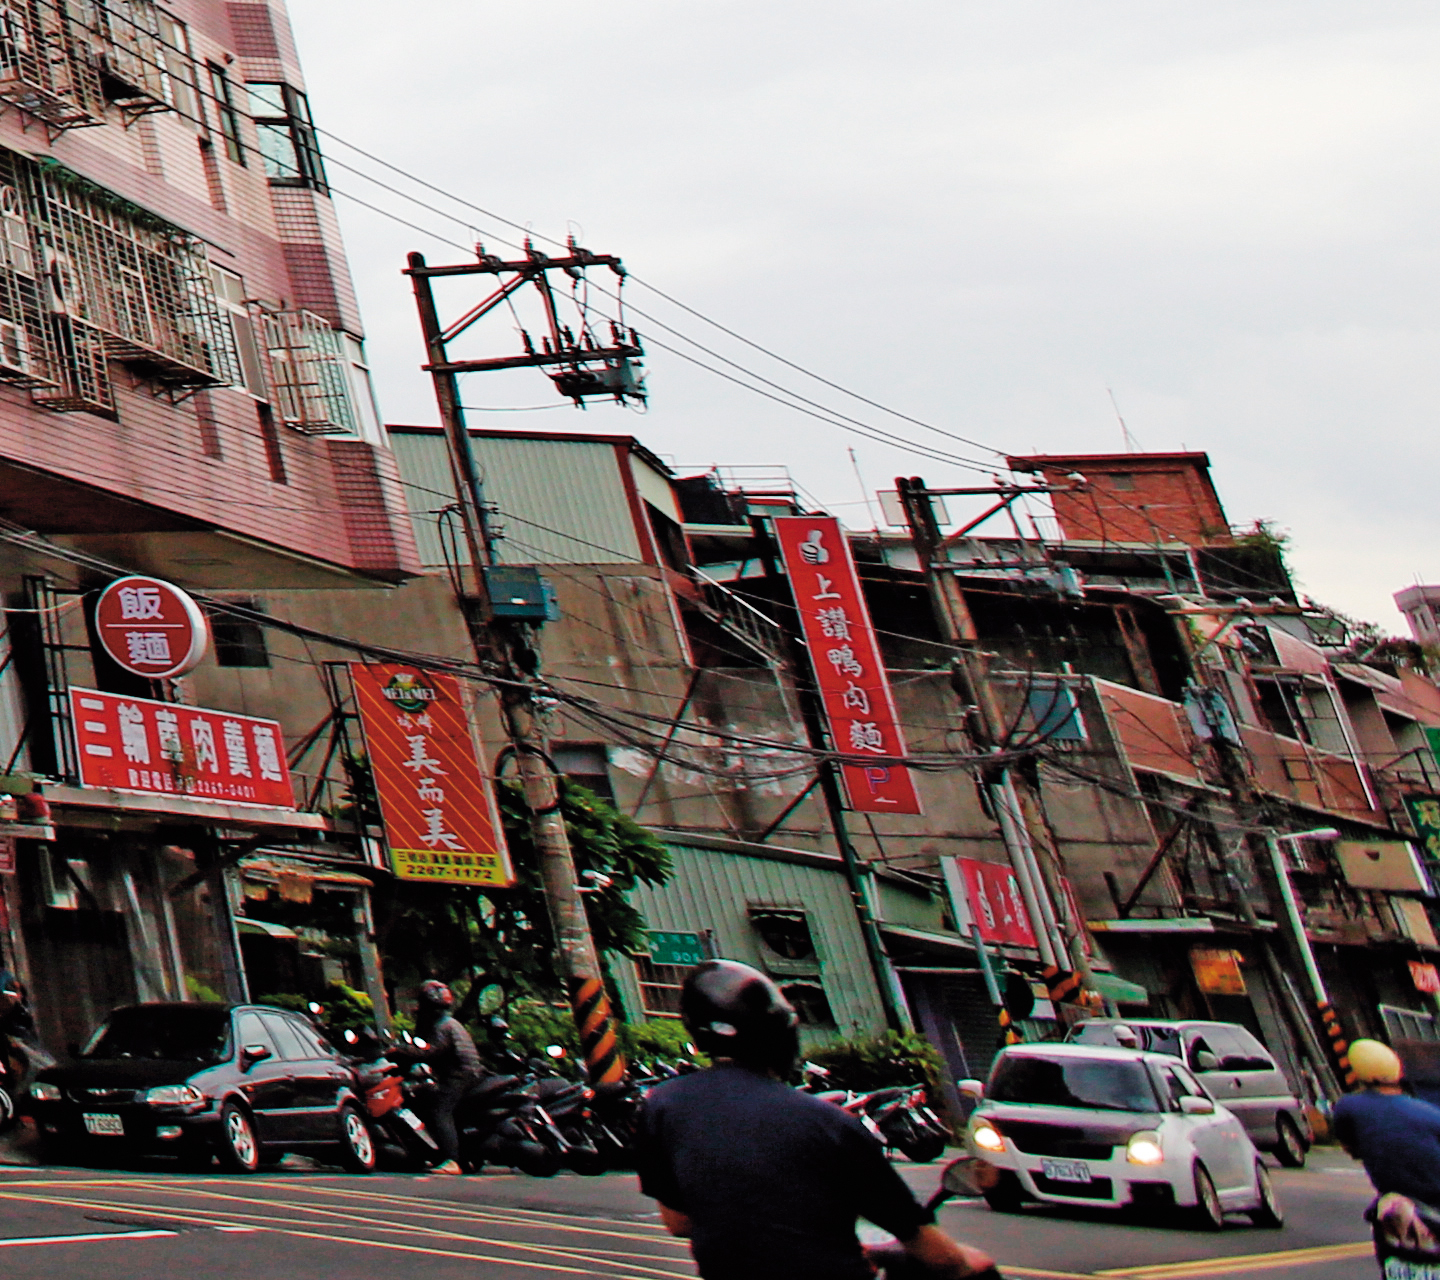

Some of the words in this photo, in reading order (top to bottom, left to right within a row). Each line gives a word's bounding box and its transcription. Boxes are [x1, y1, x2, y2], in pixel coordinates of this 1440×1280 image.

[118, 587, 165, 620] 飯
[125, 631, 173, 665] 麵
[812, 572, 887, 754] 上讚鴨肉麵
[80, 698, 283, 782] 三輪車肉羹麵
[402, 734, 467, 850] 美而美
[406, 865, 493, 879] 2267-1172
